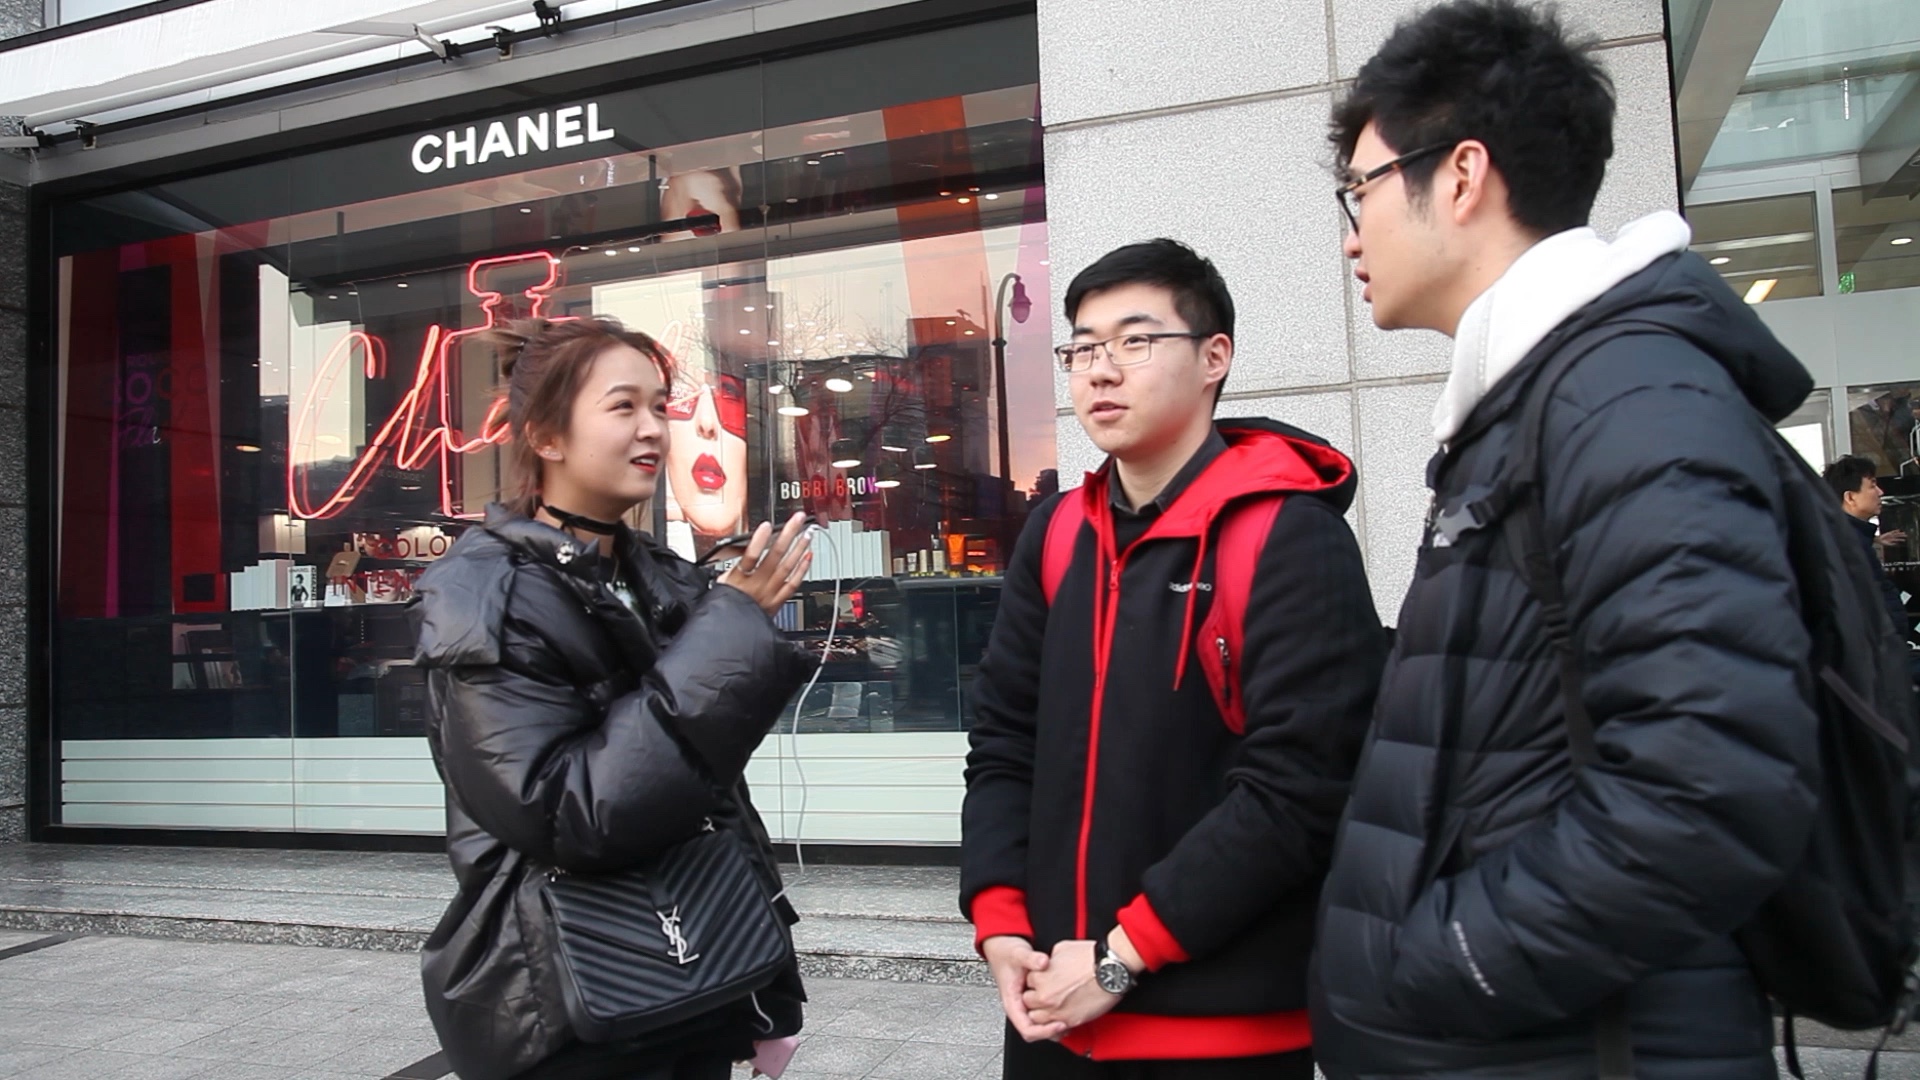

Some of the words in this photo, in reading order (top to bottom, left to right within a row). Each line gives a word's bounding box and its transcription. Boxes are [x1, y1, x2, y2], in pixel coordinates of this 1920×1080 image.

[411, 102, 615, 174] CHANEL
[780, 480, 828, 499] BOBBI
[836, 476, 879, 497] BROW
[374, 535, 456, 559] COLO
[656, 905, 700, 965] YSL
